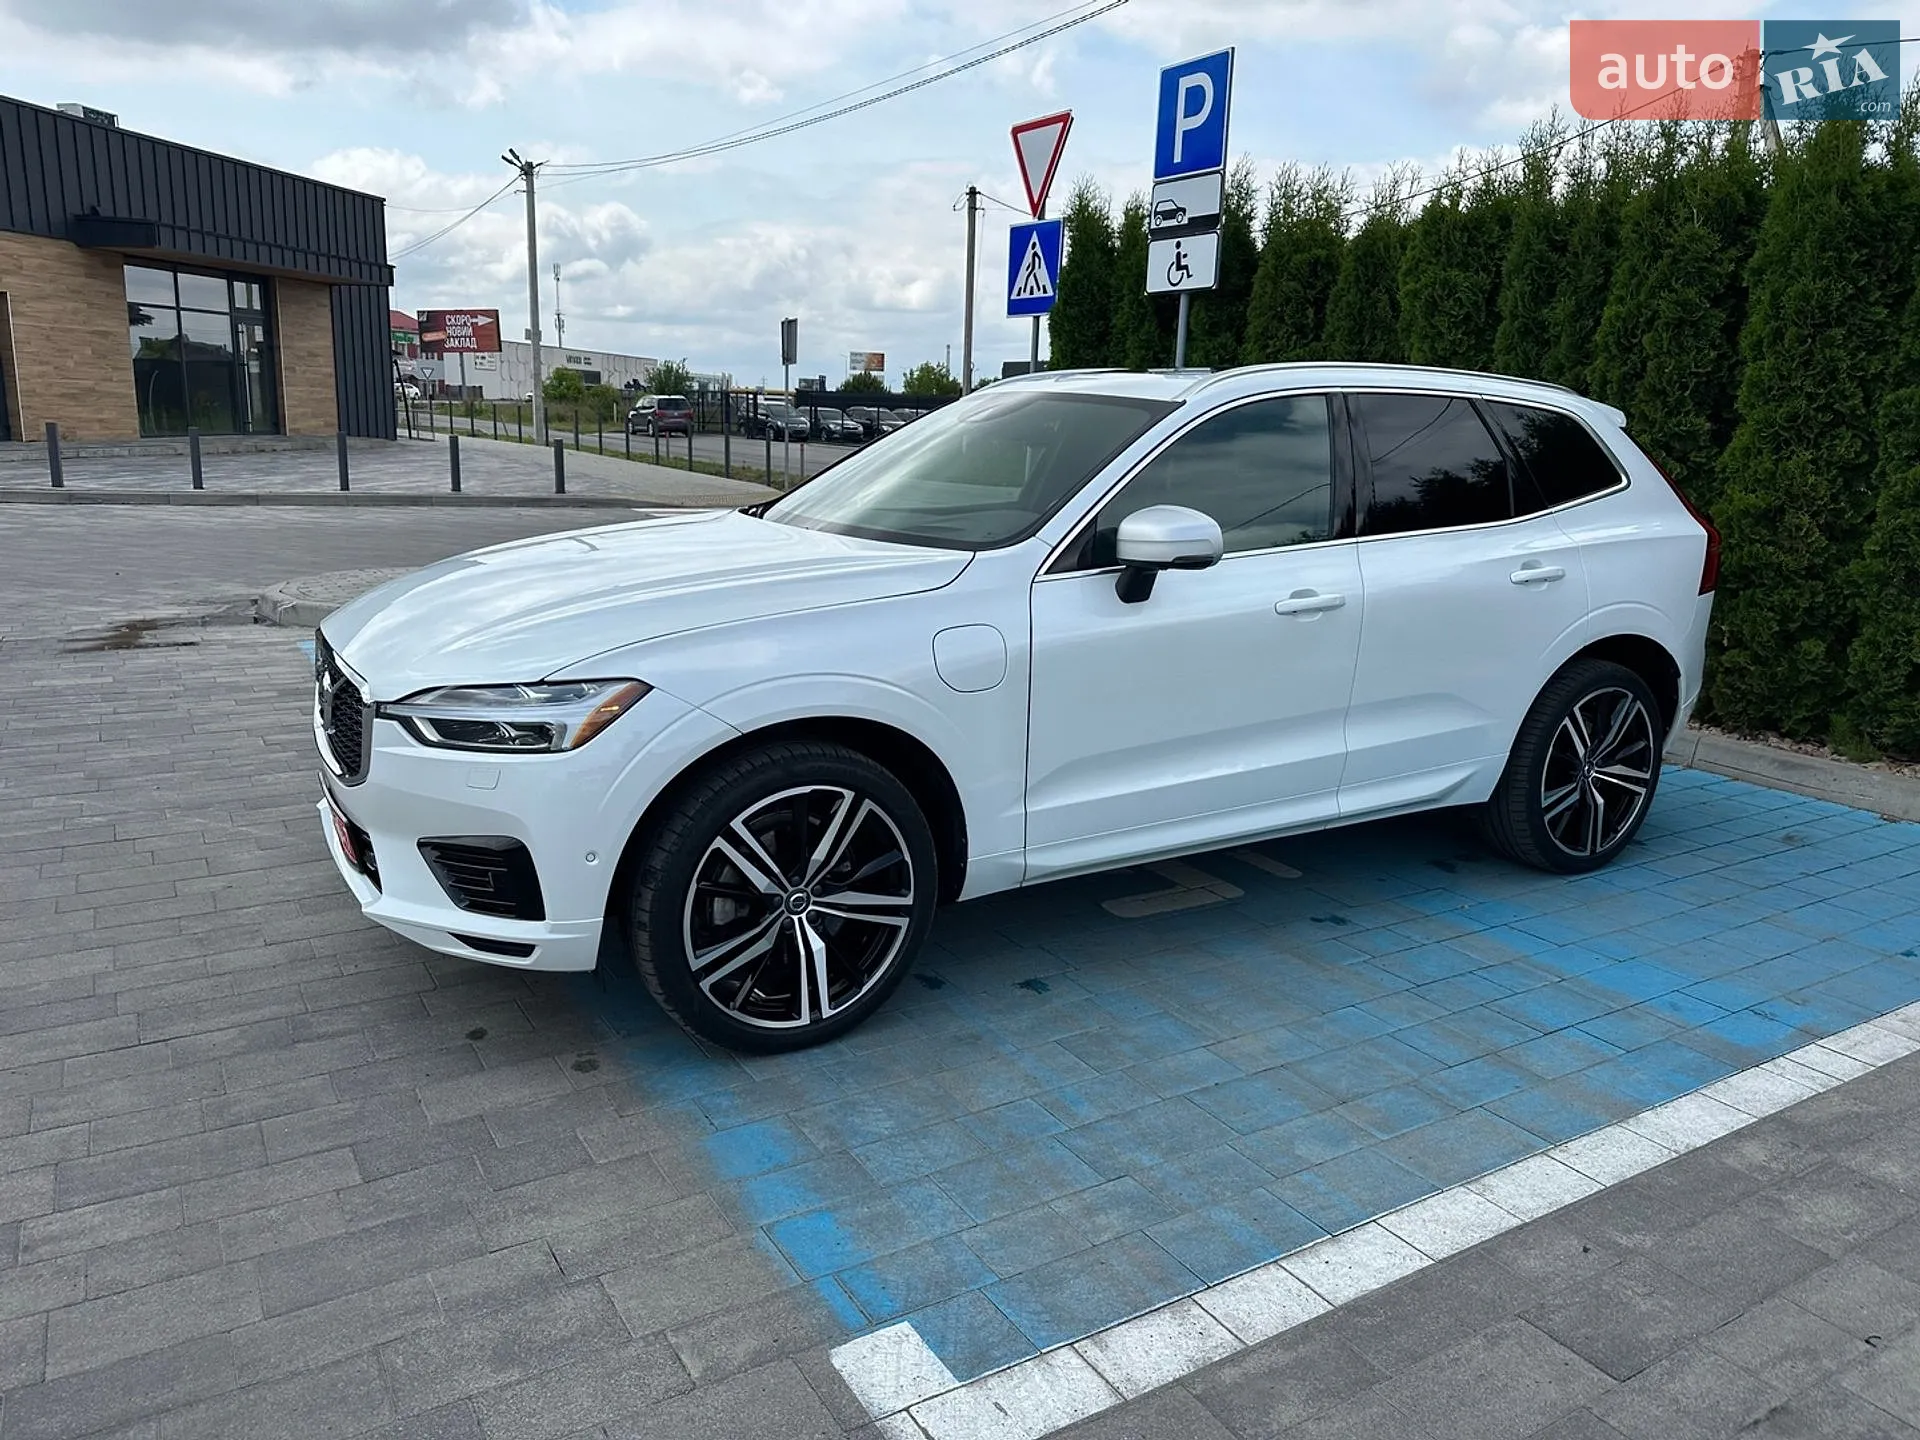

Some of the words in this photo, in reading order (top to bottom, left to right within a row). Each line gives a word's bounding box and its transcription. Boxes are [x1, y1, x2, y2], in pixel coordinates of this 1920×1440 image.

[1173, 71, 1215, 164] P
[445, 314, 472, 326] СКОРО
[444, 337, 478, 349] ЗАКЛАД
